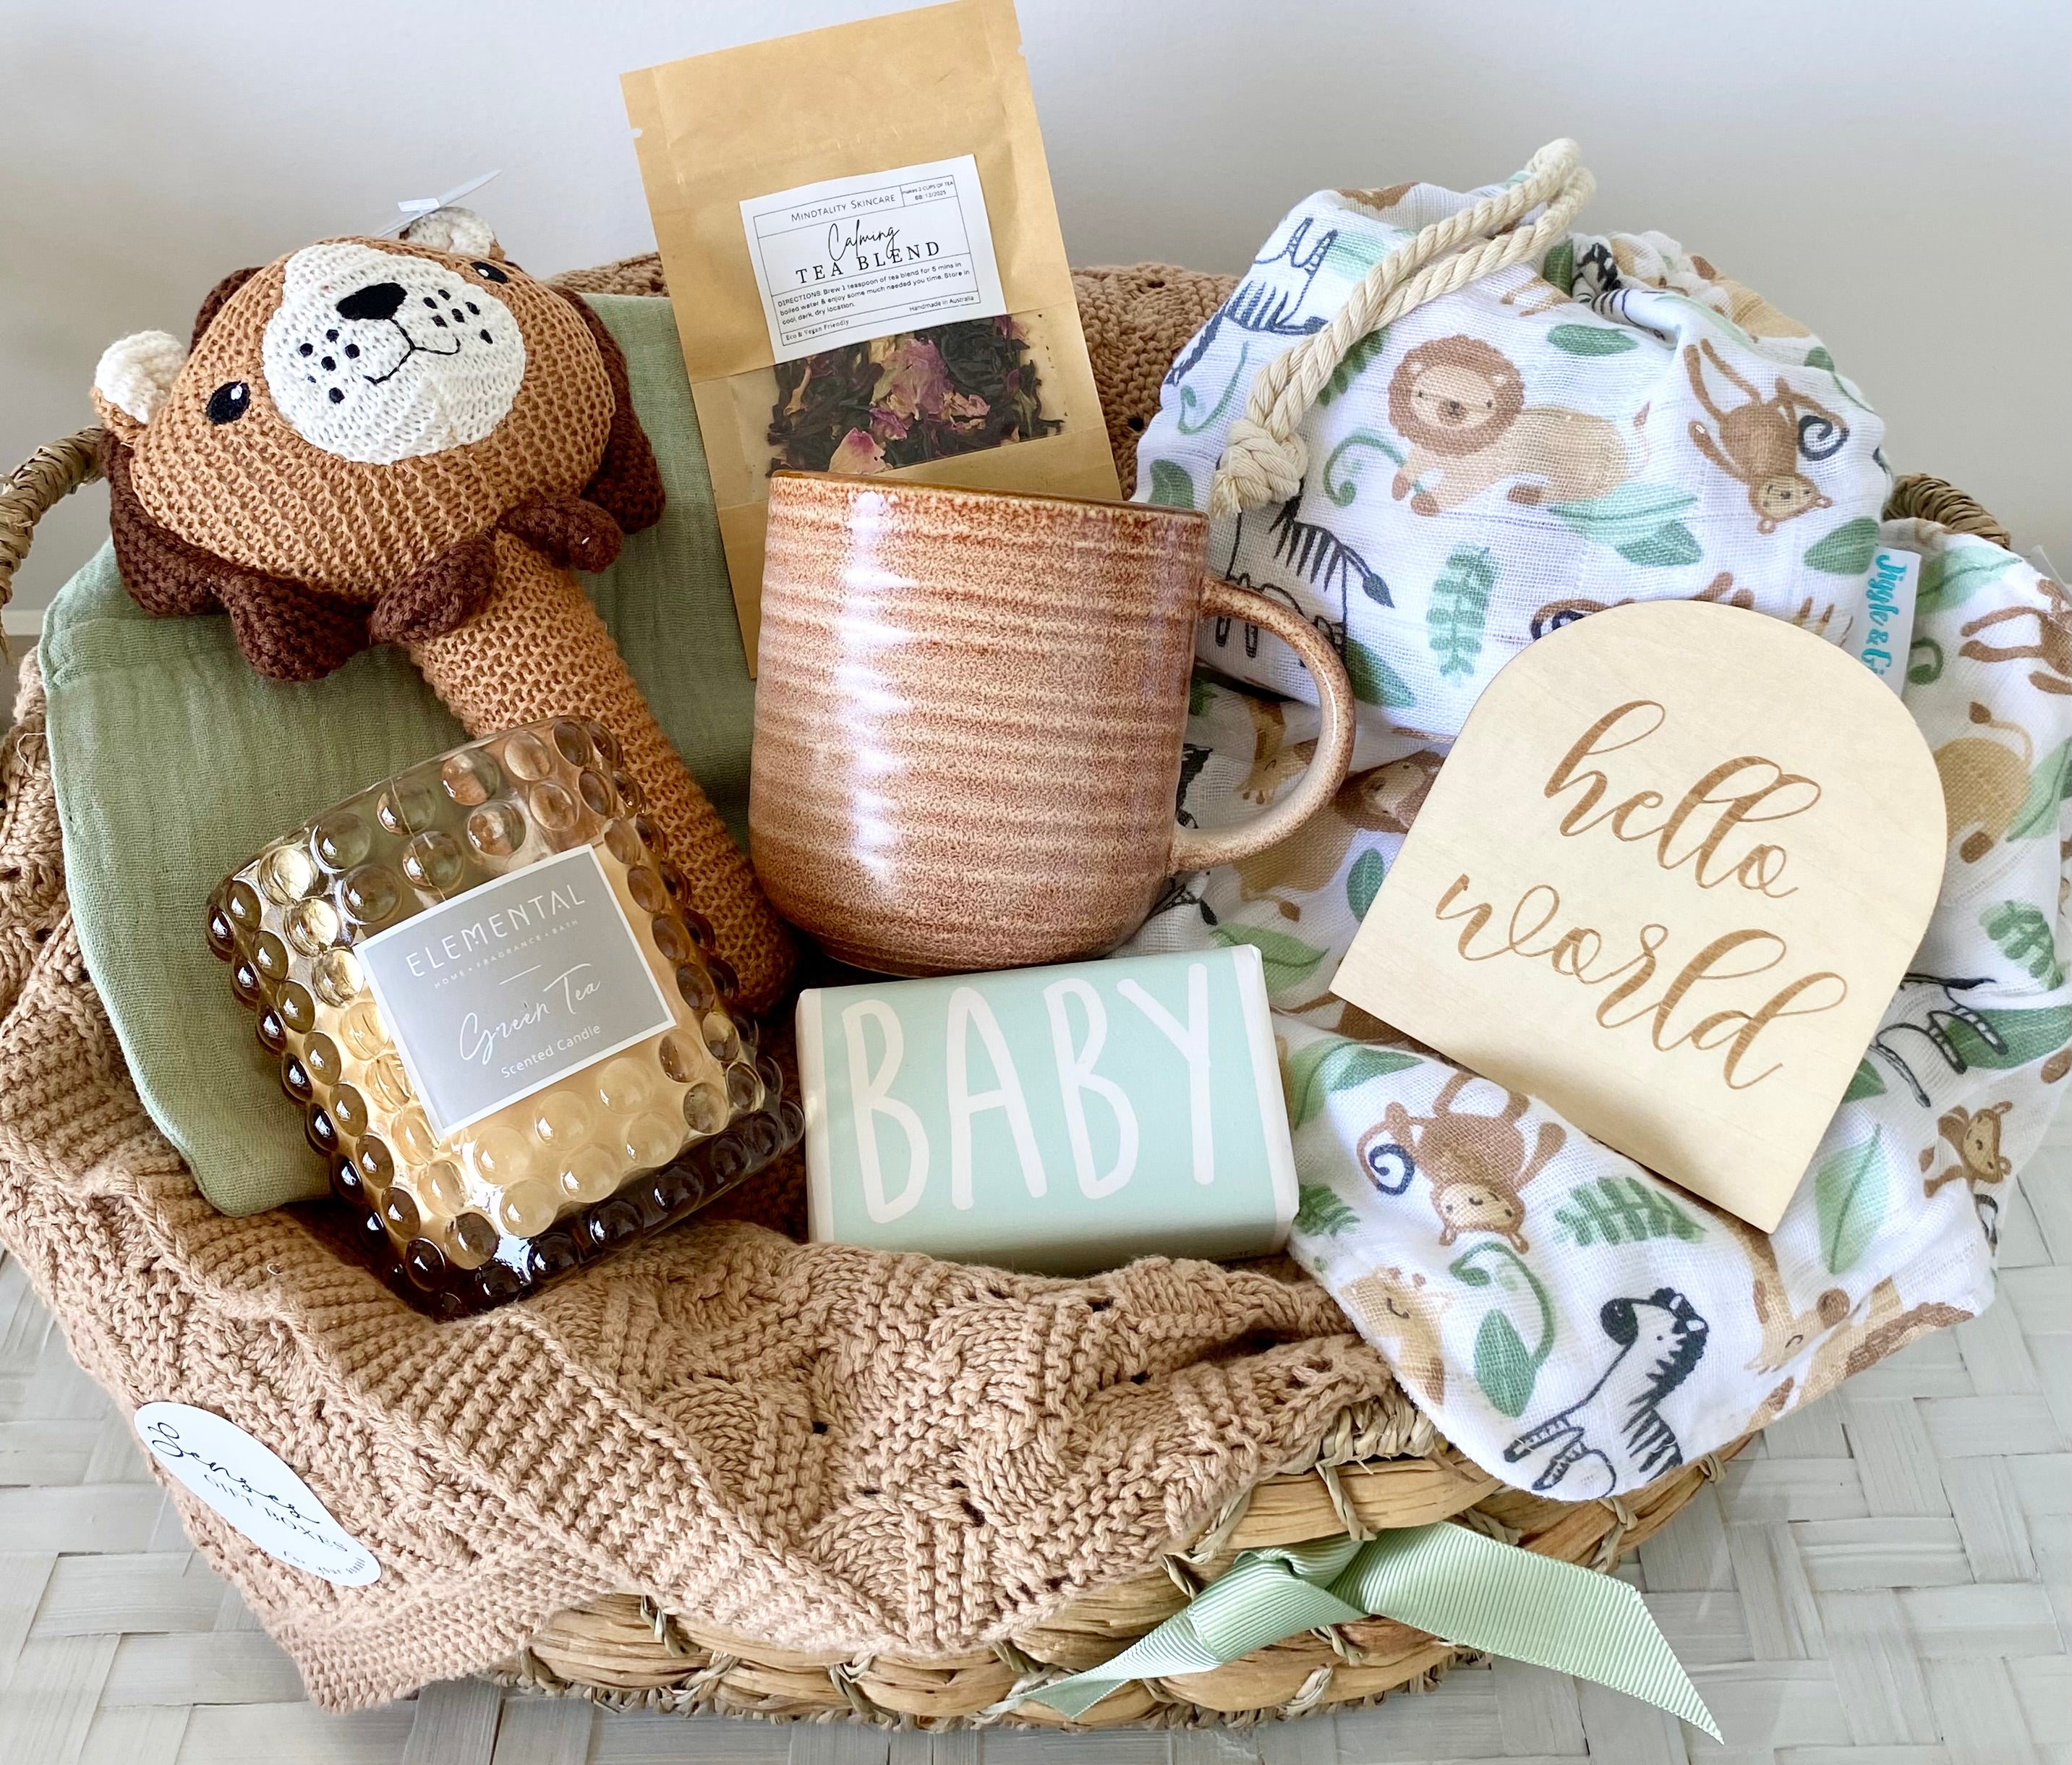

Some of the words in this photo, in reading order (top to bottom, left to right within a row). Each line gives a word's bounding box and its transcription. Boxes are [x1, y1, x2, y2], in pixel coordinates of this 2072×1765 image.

[850, 194, 896, 210] SKINCARE
[796, 262, 844, 284] TEA
[856, 242, 939, 271] BLEND
[828, 219, 900, 261] Calming
[780, 307, 800, 316] boiled
[801, 301, 819, 310] water
[827, 294, 845, 303] enjoy
[866, 284, 885, 294] much
[886, 281, 911, 290] needed
[944, 271, 963, 279] Store
[823, 286, 840, 295] Brew
[847, 278, 879, 290] teaspoon
[900, 270, 919, 278] blend
[909, 301, 942, 312] Handmade
[949, 295, 974, 304] Australia
[803, 326, 823, 336] Vegan
[823, 319, 850, 331] Friendly
[1865, 554, 1908, 626] Jiggle
[1866, 629, 1889, 645] &
[1543, 699, 1822, 899] hello
[405, 884, 585, 978] ELEMENTAL
[434, 969, 466, 989] HOME
[476, 935, 542, 969] FRAGRANCE
[552, 919, 579, 935] BATH
[1435, 873, 1848, 1090] world
[459, 1002, 550, 1065] Green
[542, 962, 602, 1014] Tea
[500, 1043, 555, 1079] Scented
[557, 1023, 602, 1052] Candle
[841, 962, 1214, 1224] BABY
[203, 1473, 254, 1507] GIFT
[262, 1505, 348, 1552] BOXES
